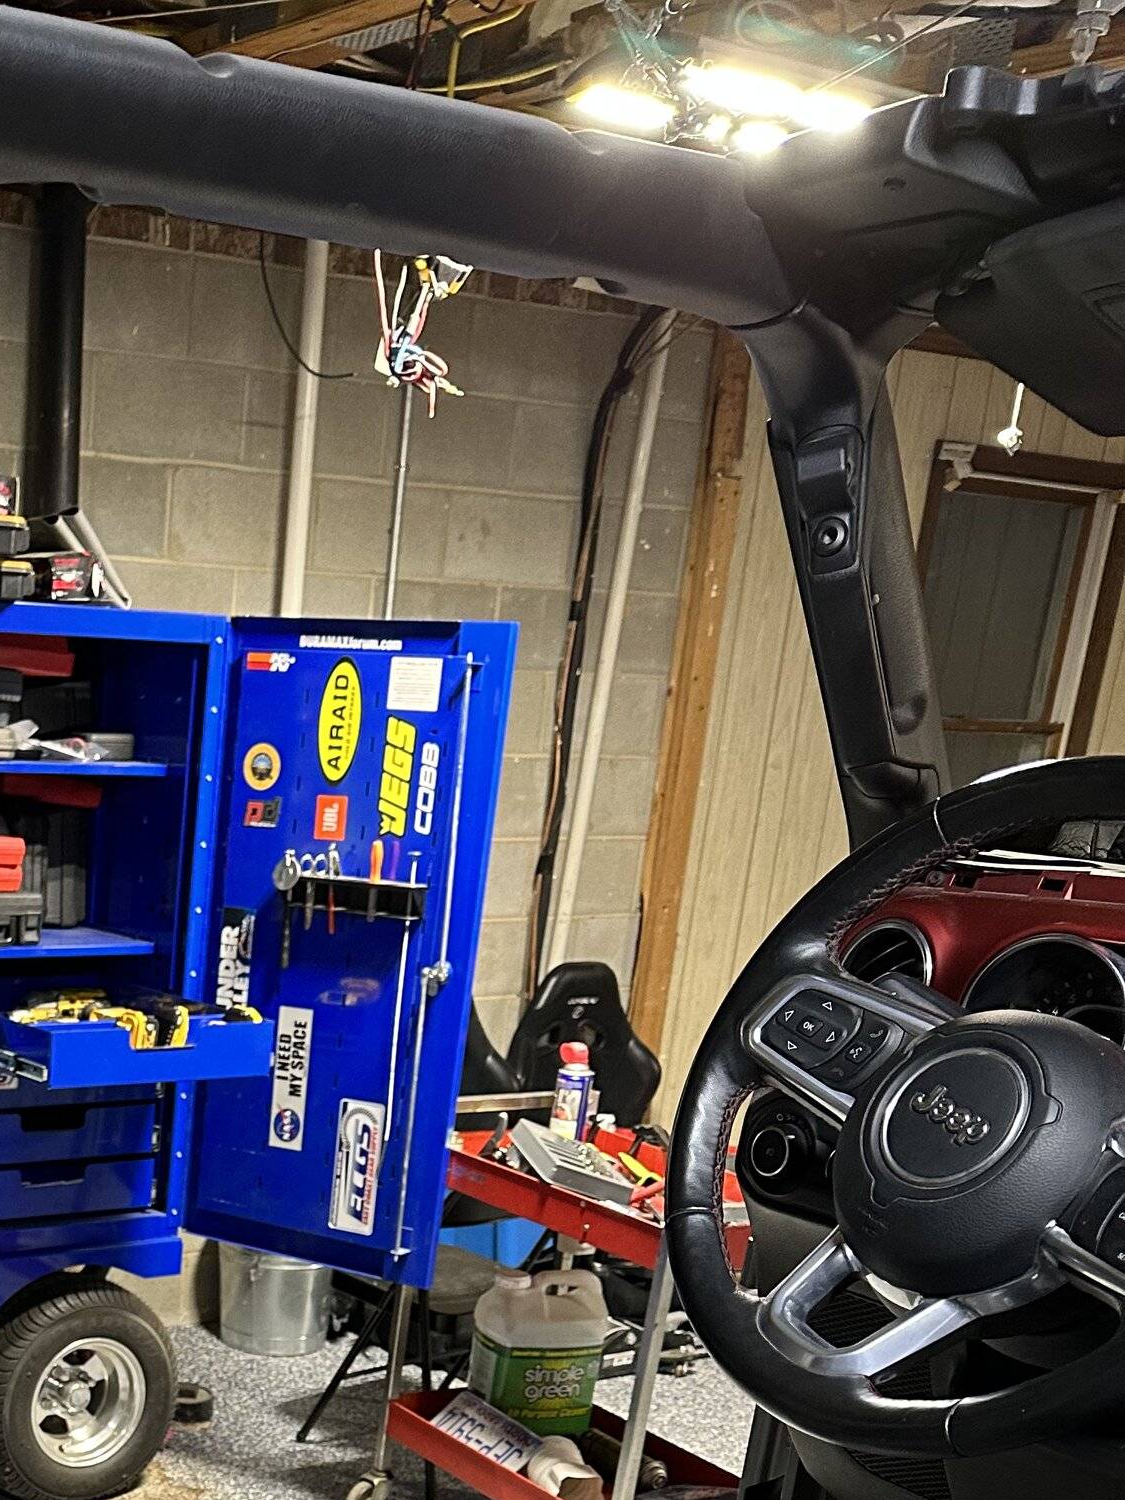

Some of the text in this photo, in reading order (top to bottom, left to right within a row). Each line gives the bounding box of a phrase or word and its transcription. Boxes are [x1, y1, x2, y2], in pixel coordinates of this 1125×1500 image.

[327, 675, 349, 771] AIRAID
[379, 717, 416, 836] JEGS
[803, 1020, 814, 1031] OK
[277, 1034, 292, 1071] NEED
[289, 1020, 307, 1097] MY SPACE
[910, 1084, 990, 1146] Jeep
[524, 1383, 580, 1402] green
[525, 1365, 584, 1385] simple
